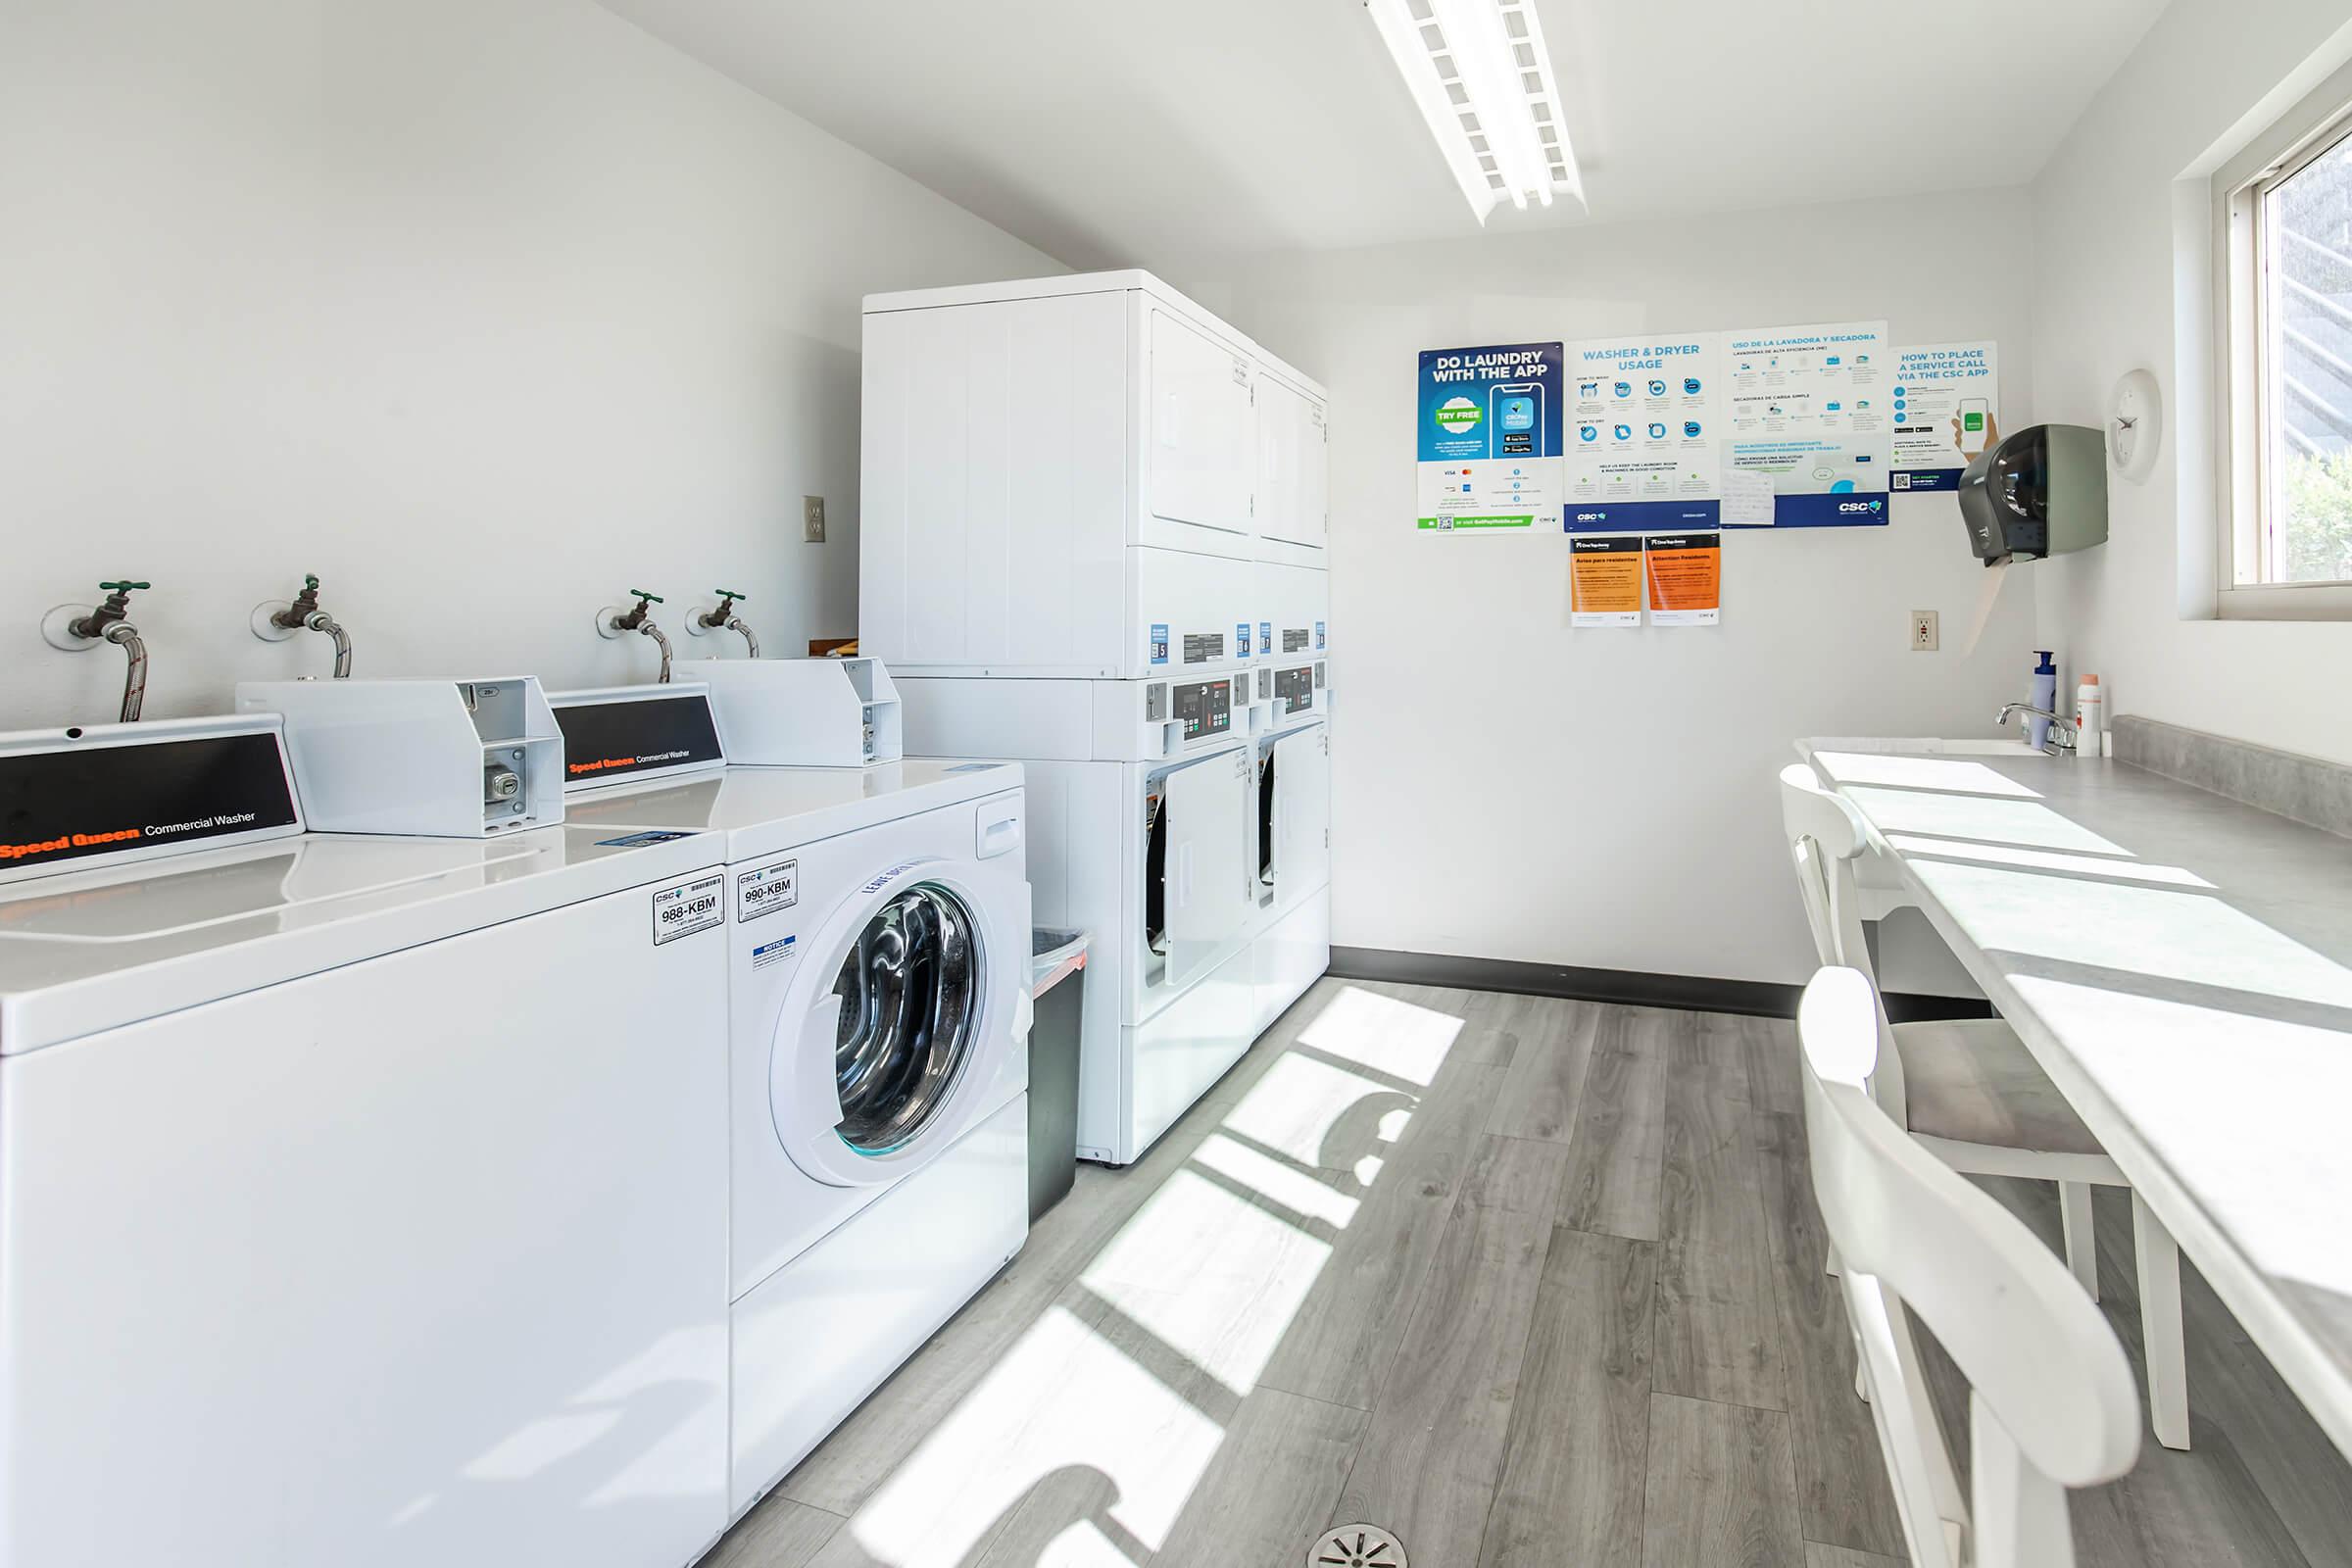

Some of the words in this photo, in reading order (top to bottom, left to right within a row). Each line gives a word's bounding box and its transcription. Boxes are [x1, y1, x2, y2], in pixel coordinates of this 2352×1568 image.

[1776, 338, 1821, 346] LAVADORA
[1583, 348, 1639, 360] WASHER
[1643, 348, 1651, 356] &
[1655, 345, 1700, 356] DRYER
[1901, 353, 1928, 361] HOW
[1949, 350, 1984, 358] PLACE
[1437, 357, 1460, 369] DO
[1465, 351, 1544, 368] LAUNDRY
[1618, 360, 1663, 370] USAGE
[1910, 361, 1955, 370] SERVICE
[1433, 368, 1474, 382] WITH
[1478, 367, 1510, 379] THE
[1514, 364, 1548, 378] APP
[1438, 412, 1455, 420] TRY
[1457, 411, 1480, 419] FREE
[1839, 503, 1868, 511] CSC
[1160, 645, 1165, 656] 5
[569, 760, 602, 774] Speed
[604, 757, 635, 768] Queen
[637, 752, 670, 764] Commercial
[670, 749, 690, 759] Washer
[0, 836, 70, 859] Speed
[73, 828, 140, 847] Queen
[145, 817, 213, 836] Commercial
[214, 812, 255, 826] Washer
[740, 875, 756, 884] CSC
[745, 879, 791, 902] 990-KBM
[656, 892, 674, 902] CSC
[662, 896, 715, 922] 988-KBM
[764, 940, 784, 951] NOTICE
